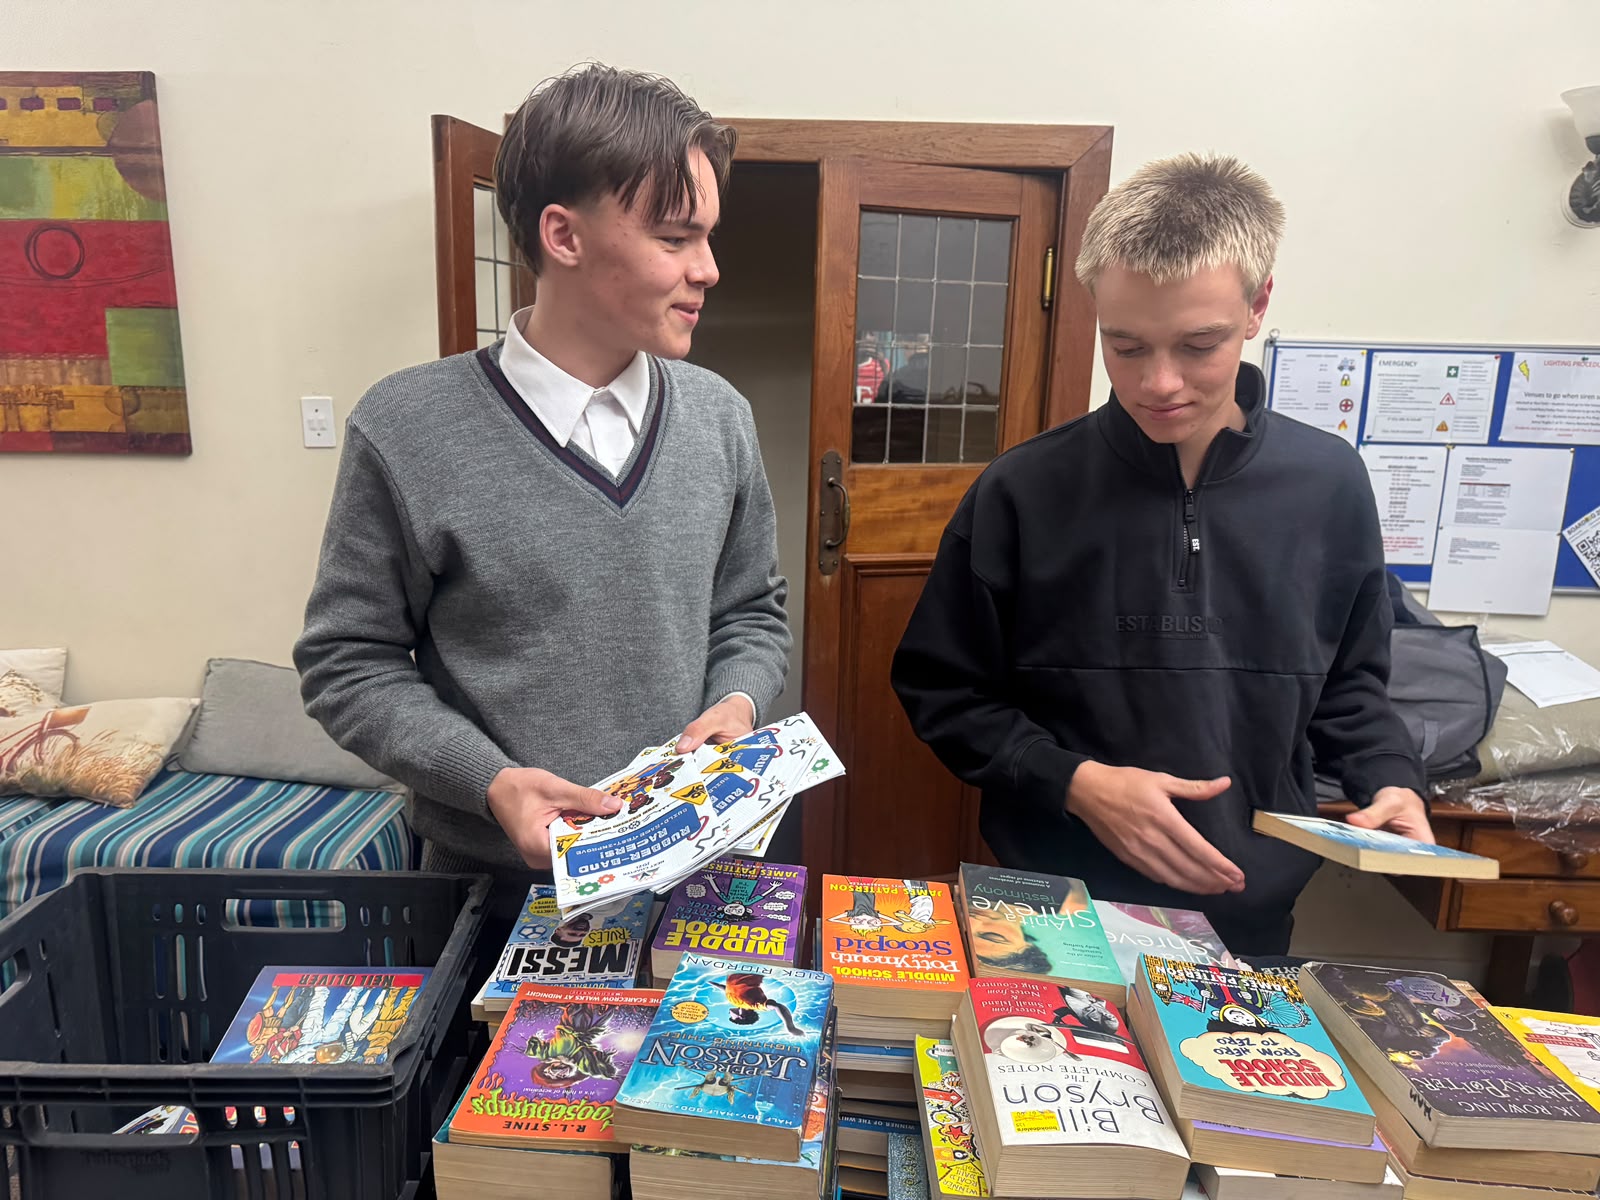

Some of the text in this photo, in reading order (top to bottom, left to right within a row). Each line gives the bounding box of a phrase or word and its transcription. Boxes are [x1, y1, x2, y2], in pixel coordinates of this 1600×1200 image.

[578, 824, 690, 874] RUBBER-BAND
[598, 828, 668, 858] RACERS!
[760, 870, 798, 878] JAMES
[830, 884, 942, 896] JAMES PATTERSON
[974, 884, 1060, 906] Testimony
[676, 906, 724, 918] ROTTEN
[686, 900, 716, 910] LUCK
[972, 894, 1096, 928] Shreve
[672, 912, 690, 920] MY
[1004, 912, 1064, 930] Anita
[588, 928, 626, 944] RULES
[670, 918, 790, 942] SCHOOL
[664, 932, 784, 956] MIDDLE
[832, 934, 952, 956] Stoopid
[1104, 930, 1208, 960] Shreve
[508, 944, 630, 976] MESSI
[686, 956, 826, 980] RICK RIORDAN
[830, 952, 960, 972] Pottymouth
[298, 974, 396, 988] NEIL OLIVER
[832, 966, 956, 982] MIDDLE SCHOOL
[1154, 966, 1238, 986] PATTERSON
[974, 980, 1020, 990] Country
[1010, 988, 1040, 996] Notes
[1022, 982, 1040, 992] Big
[1242, 978, 1290, 992] JAMES
[524, 990, 562, 998] MIDNIGHT
[602, 996, 648, 1004] SCARECROW
[992, 1006, 1046, 1016] Notes from
[660, 1032, 800, 1052] LIGHTNING THIEF
[1216, 1036, 1280, 1046] TO ZERO
[640, 1038, 806, 1080] JACKSON
[1212, 1046, 1300, 1058] FROM HERO
[688, 1060, 760, 1076] PERCY
[1218, 1058, 1320, 1072] SCHOOL
[996, 1064, 1146, 1088] COMPLETE NOTES
[1064, 1074, 1088, 1082] The
[1230, 1072, 1336, 1086] MIDDLE
[1410, 1076, 1584, 1102] HARRY POTTER
[1002, 1078, 1164, 1124] Bryson
[1458, 1100, 1580, 1118] J.K. ROWLING
[706, 1108, 734, 1116] HALF
[764, 1116, 792, 1126] HALF
[886, 1122, 914, 1130] WINNER
[1056, 1108, 1120, 1134] Bill
[942, 1180, 978, 1196] WINNER
